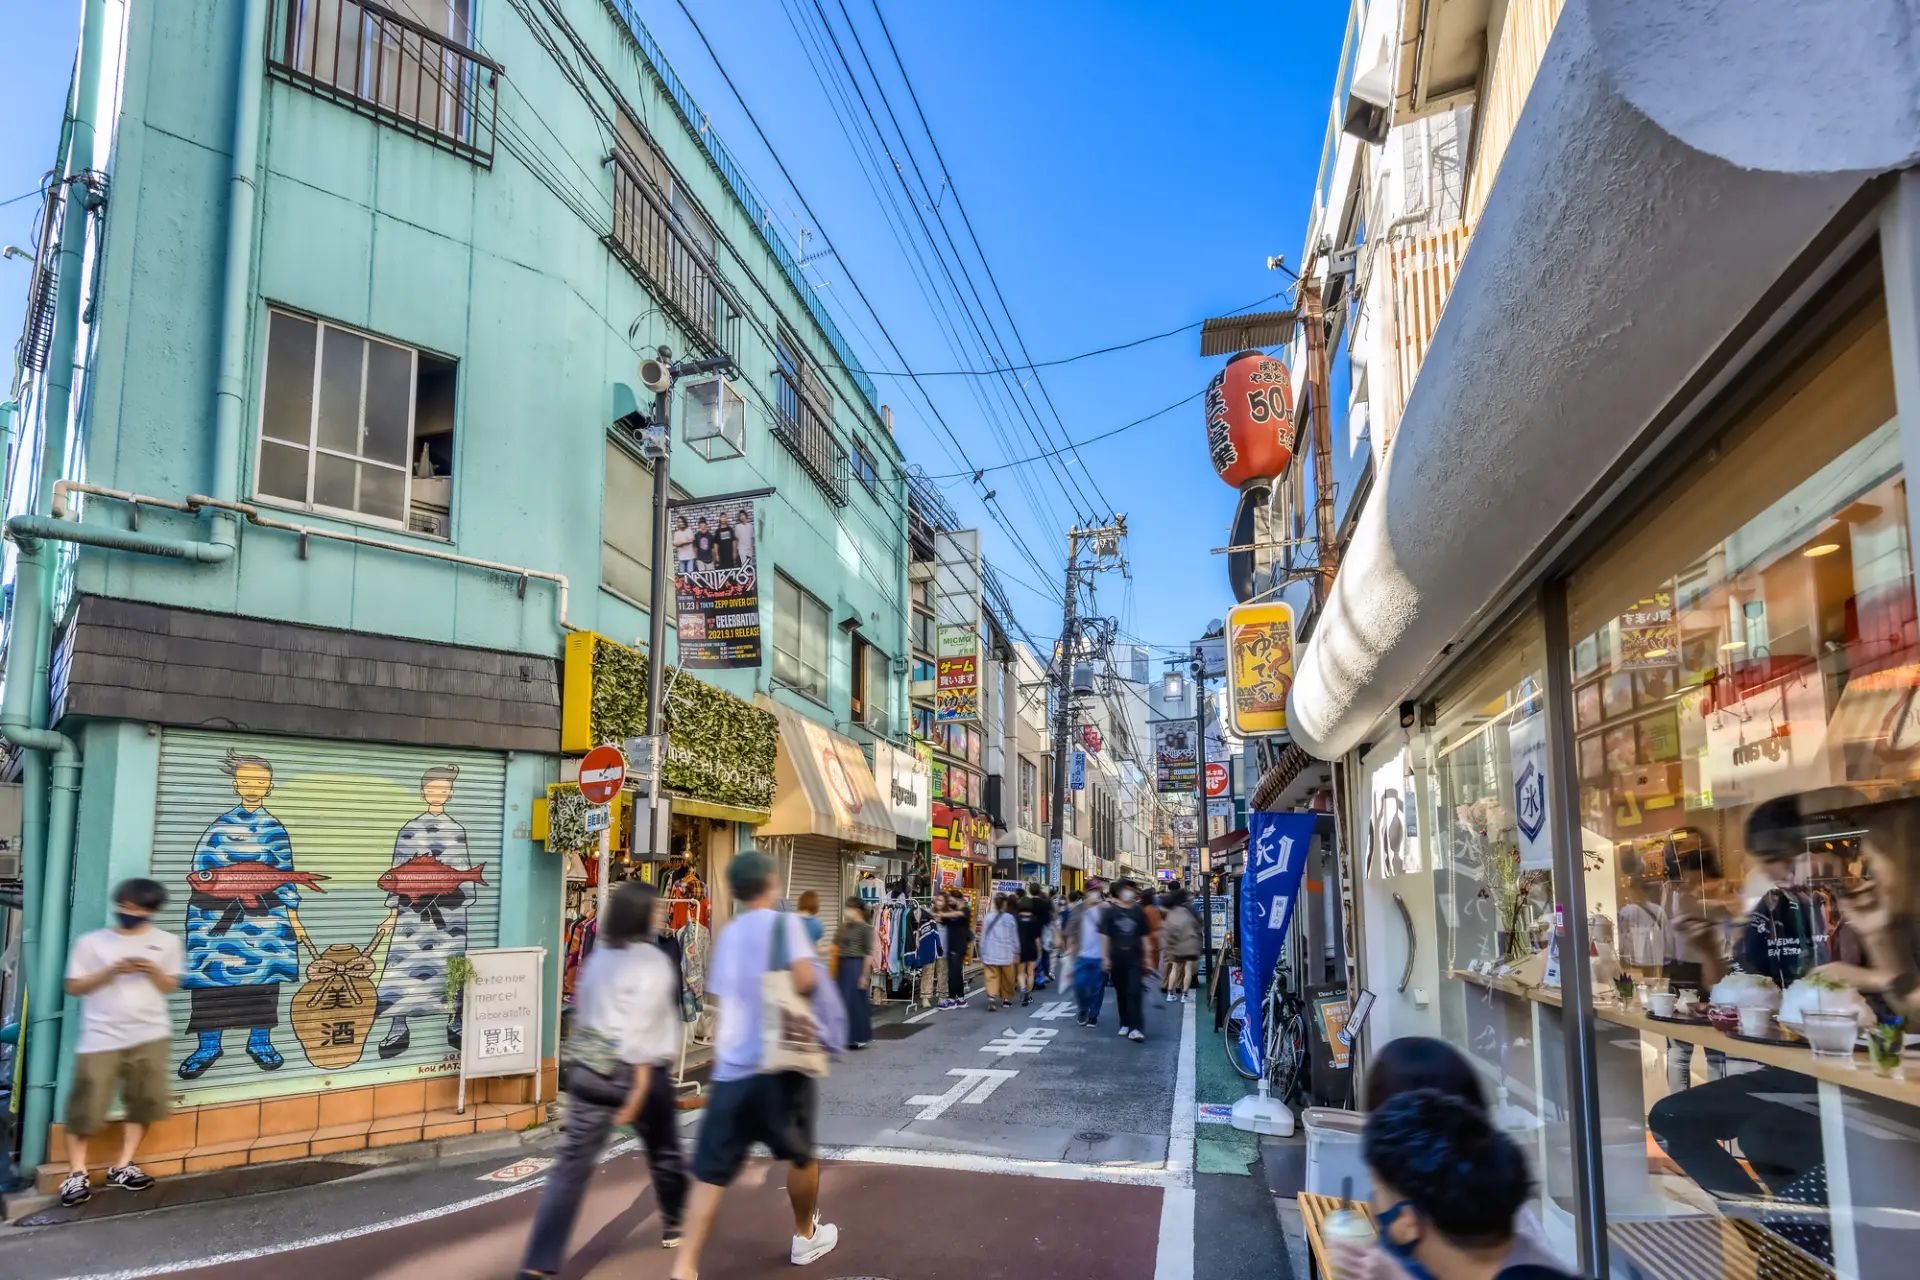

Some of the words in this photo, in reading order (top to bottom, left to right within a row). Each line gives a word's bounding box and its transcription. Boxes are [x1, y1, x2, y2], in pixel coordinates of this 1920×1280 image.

[1249, 372, 1290, 388] やきとり
[678, 602, 695, 610] 11.23
[715, 600, 728, 609] ZEPP
[729, 598, 746, 607] DIVER
[715, 612, 760, 629] CELEBRATION
[708, 629, 735, 640] 2021.9.1
[735, 627, 760, 638] RELEASE
[940, 660, 974, 674] ゲーム
[940, 674, 975, 686] 買います
[1523, 784, 1539, 818] 氷
[475, 973, 526, 986] etienne
[475, 987, 518, 1002] marcel
[320, 985, 356, 1047] 美酒
[475, 1007, 531, 1020] laboratoire
[484, 1028, 521, 1048] 買取
